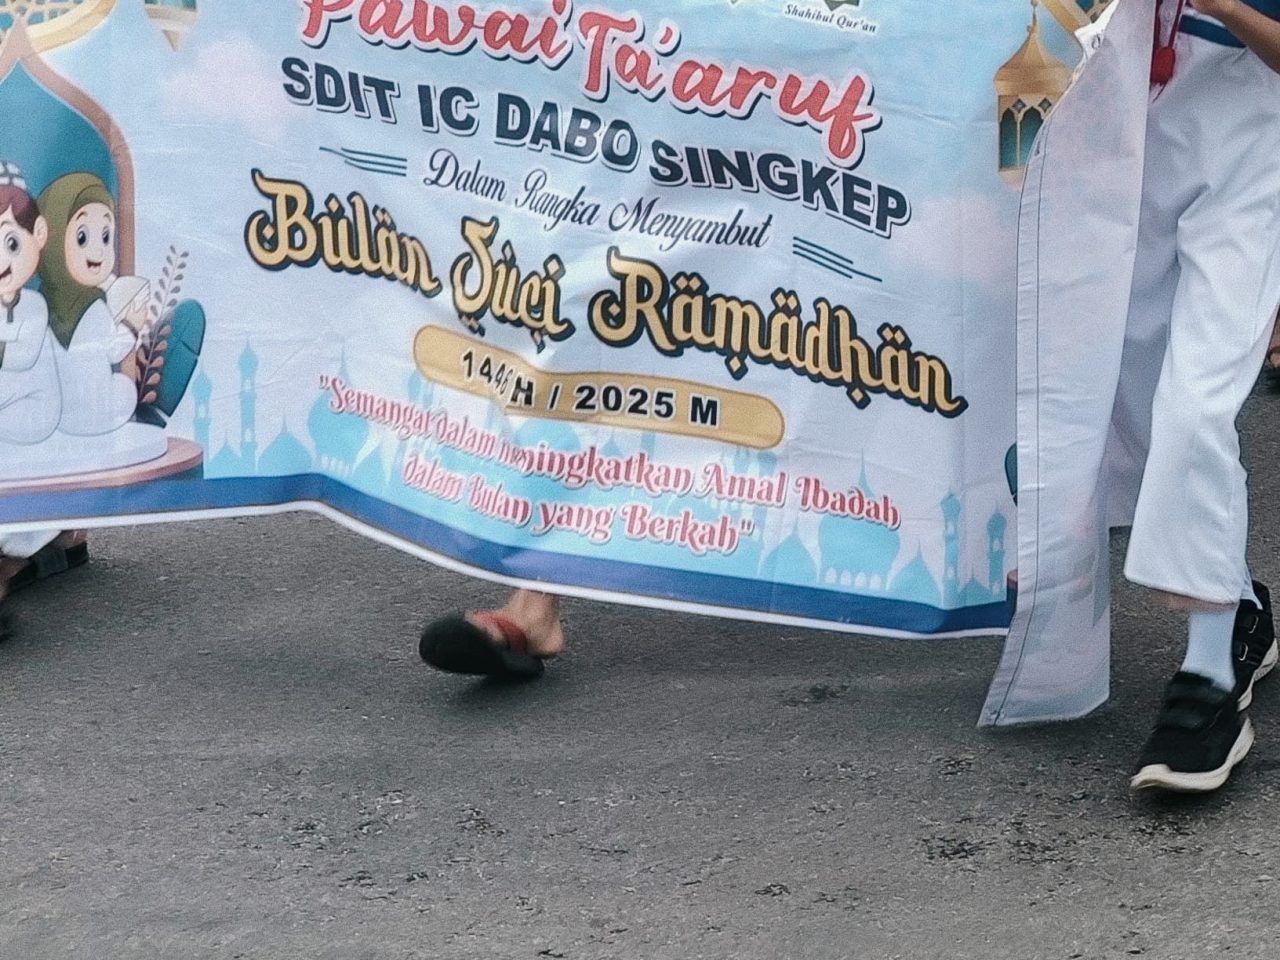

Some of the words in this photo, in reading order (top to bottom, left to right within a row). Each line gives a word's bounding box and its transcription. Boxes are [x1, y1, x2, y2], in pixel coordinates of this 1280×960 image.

[784, 3, 835, 24] Shahibul
[836, 14, 877, 33] Qur'an
[578, 10, 876, 164] Ta'aruf
[281, 56, 399, 123] SDIT
[417, 84, 479, 135] IC
[495, 92, 639, 170] DABO
[650, 139, 910, 236] SINGKEP
[423, 147, 507, 202] Dalam
[515, 168, 600, 232] Rangka
[608, 196, 774, 252] Menyambut
[549, 385, 559, 409] /
[575, 384, 675, 419] 2025
[690, 395, 719, 427] M
[404, 451, 462, 502] dalam
[470, 474, 531, 524] Bulan
[535, 500, 613, 541] yang
[622, 504, 755, 556] Berkah"
[435, 409, 496, 455] dalam
[702, 463, 787, 504] Amal
[796, 476, 900, 527] Ibadah
